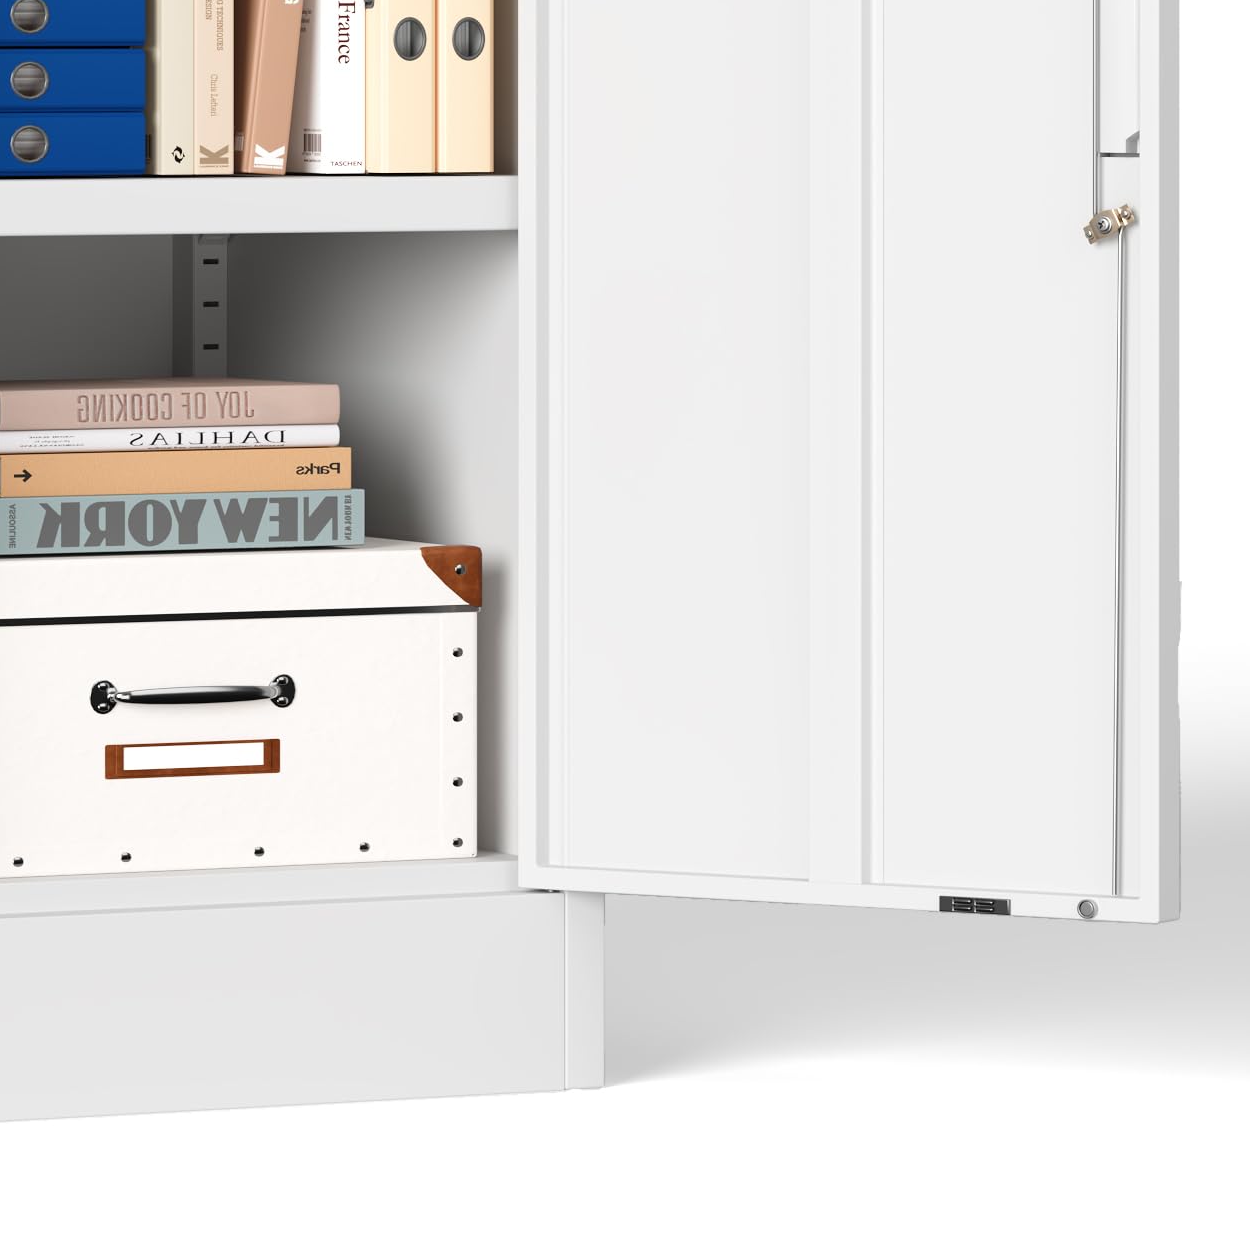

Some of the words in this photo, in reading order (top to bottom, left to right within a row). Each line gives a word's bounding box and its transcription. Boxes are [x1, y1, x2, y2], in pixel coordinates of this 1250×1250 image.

[216, 6, 224, 52] TECHNIQUES
[337, 1, 356, 65] France
[210, 73, 218, 92] Chris
